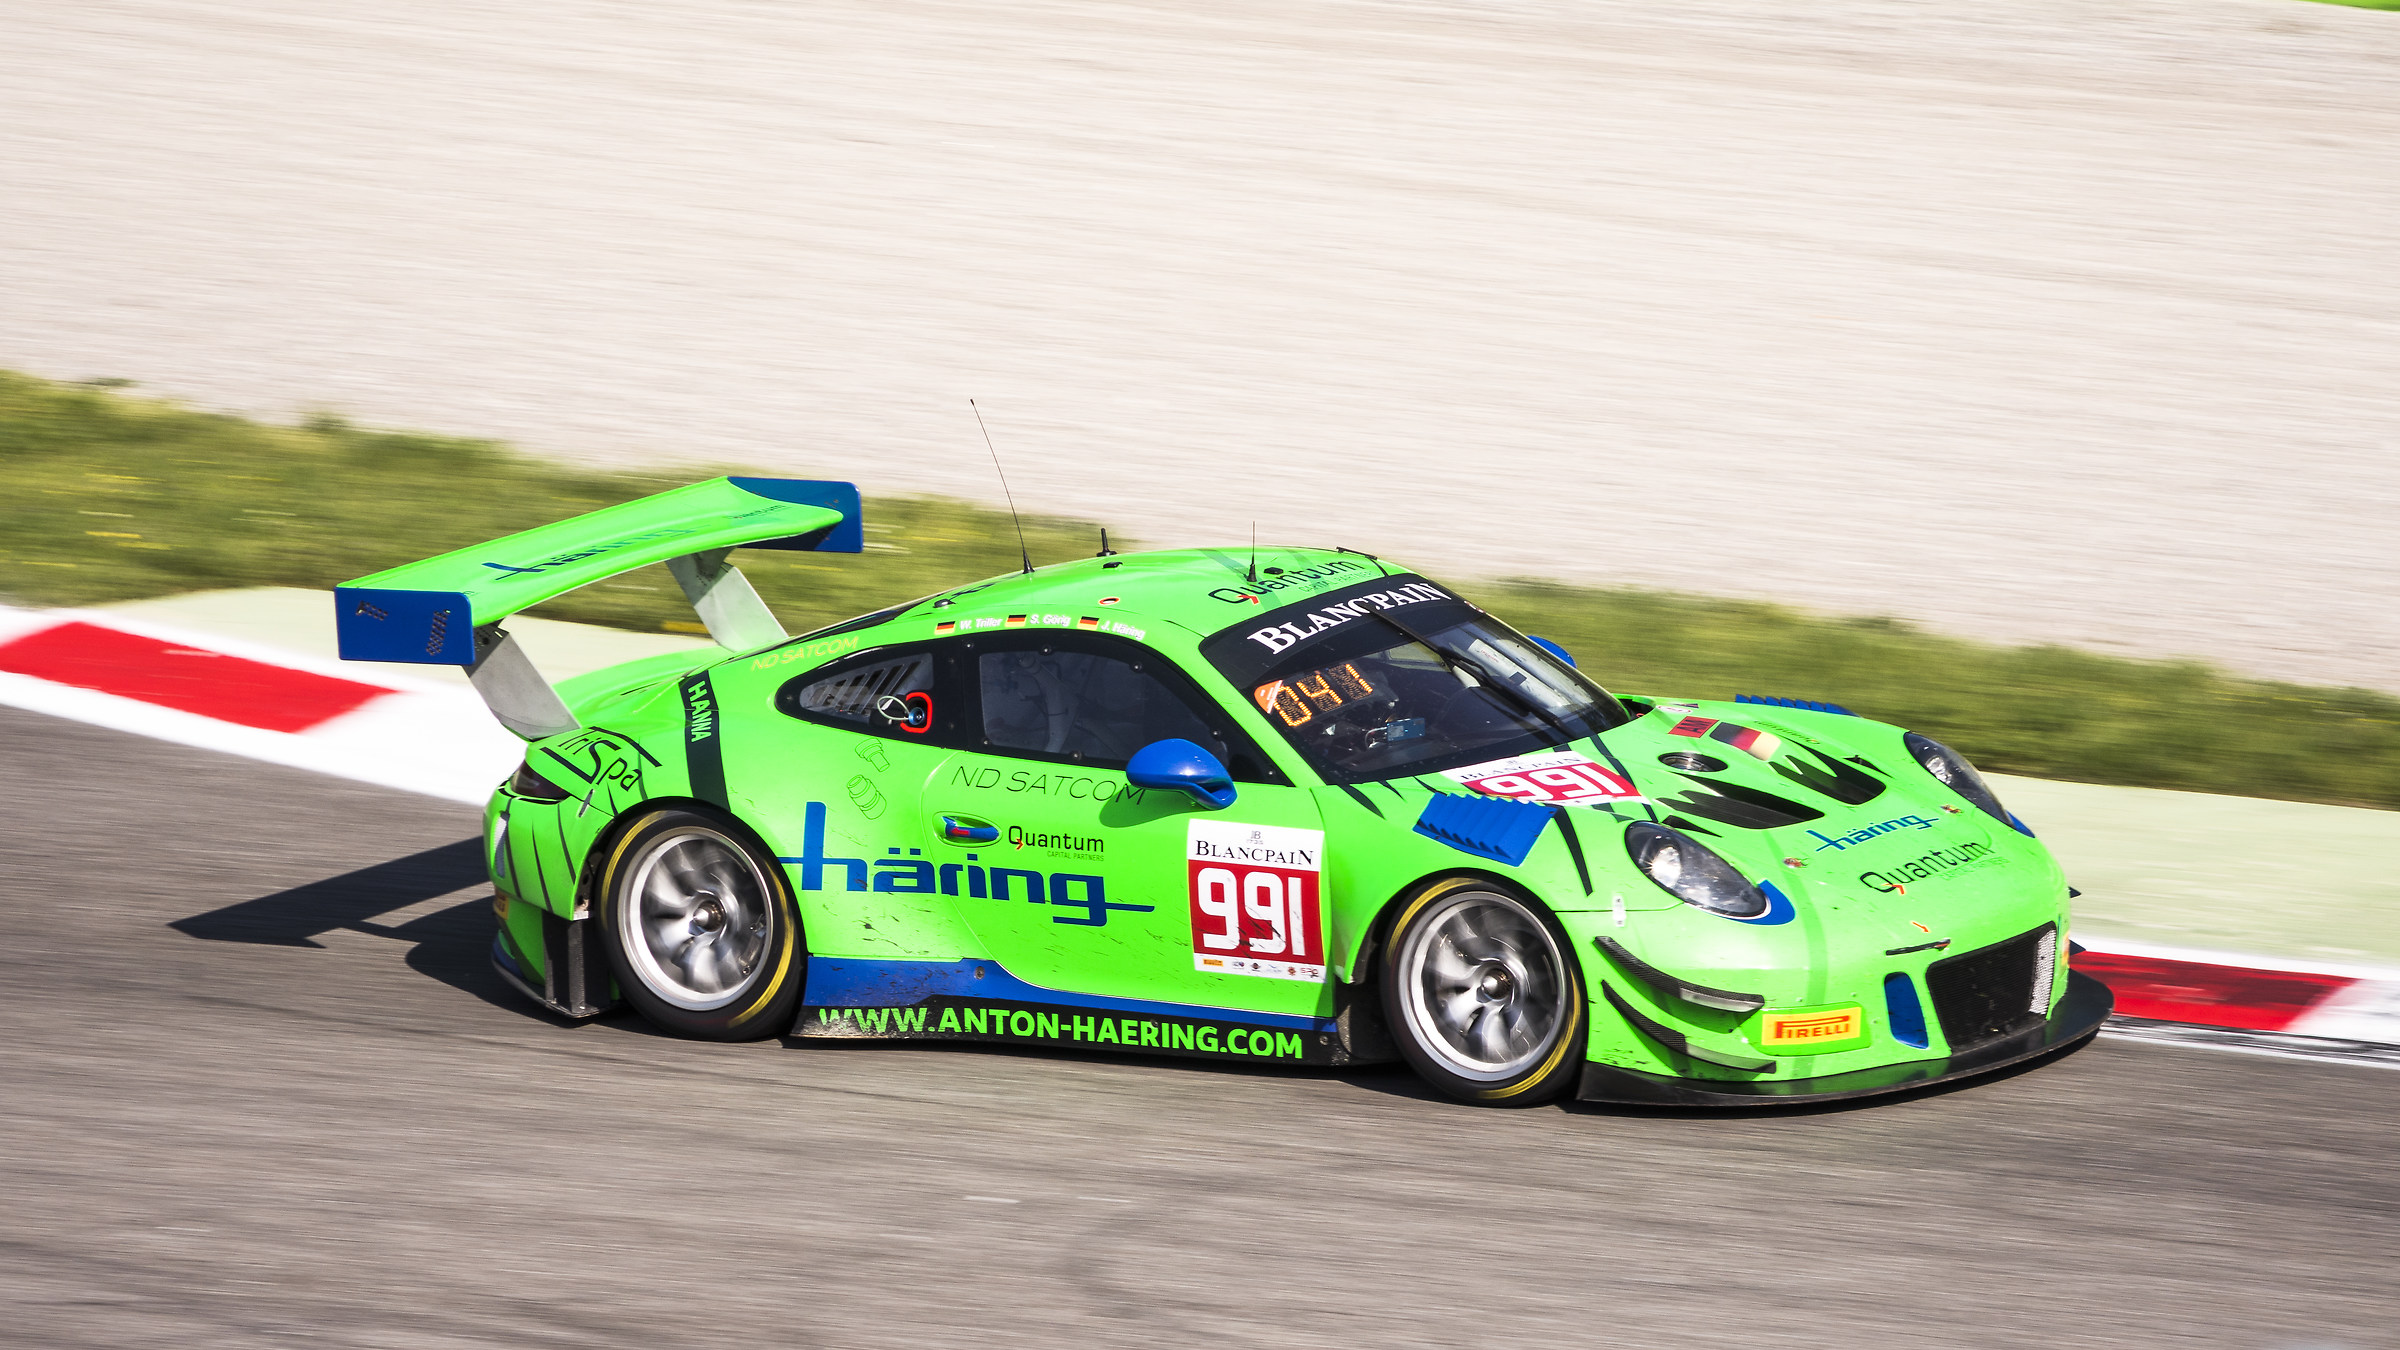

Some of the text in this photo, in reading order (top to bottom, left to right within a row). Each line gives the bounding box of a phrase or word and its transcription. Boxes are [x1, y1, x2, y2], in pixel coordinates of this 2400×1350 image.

[1207, 560, 1366, 605] Quantum
[1246, 582, 1452, 656] BLANCPAIN
[751, 635, 860, 672] ND SATCOM
[687, 680, 713, 743] HANNA
[951, 765, 1146, 806] ND SATCOM
[1479, 764, 1627, 801] 991
[1008, 825, 1105, 853] Quantum
[1195, 840, 1314, 866] BLANCPAIN
[1806, 814, 1940, 851] häring
[778, 801, 1156, 928] häring
[1047, 850, 1105, 862] CAPITAL PARTNERS
[1859, 842, 1996, 894] Quantum
[1197, 867, 1306, 956] 991
[818, 1006, 1304, 1060] WWW.ANTON-HAERING.COM
[1773, 1015, 1850, 1039] PIRELLI
